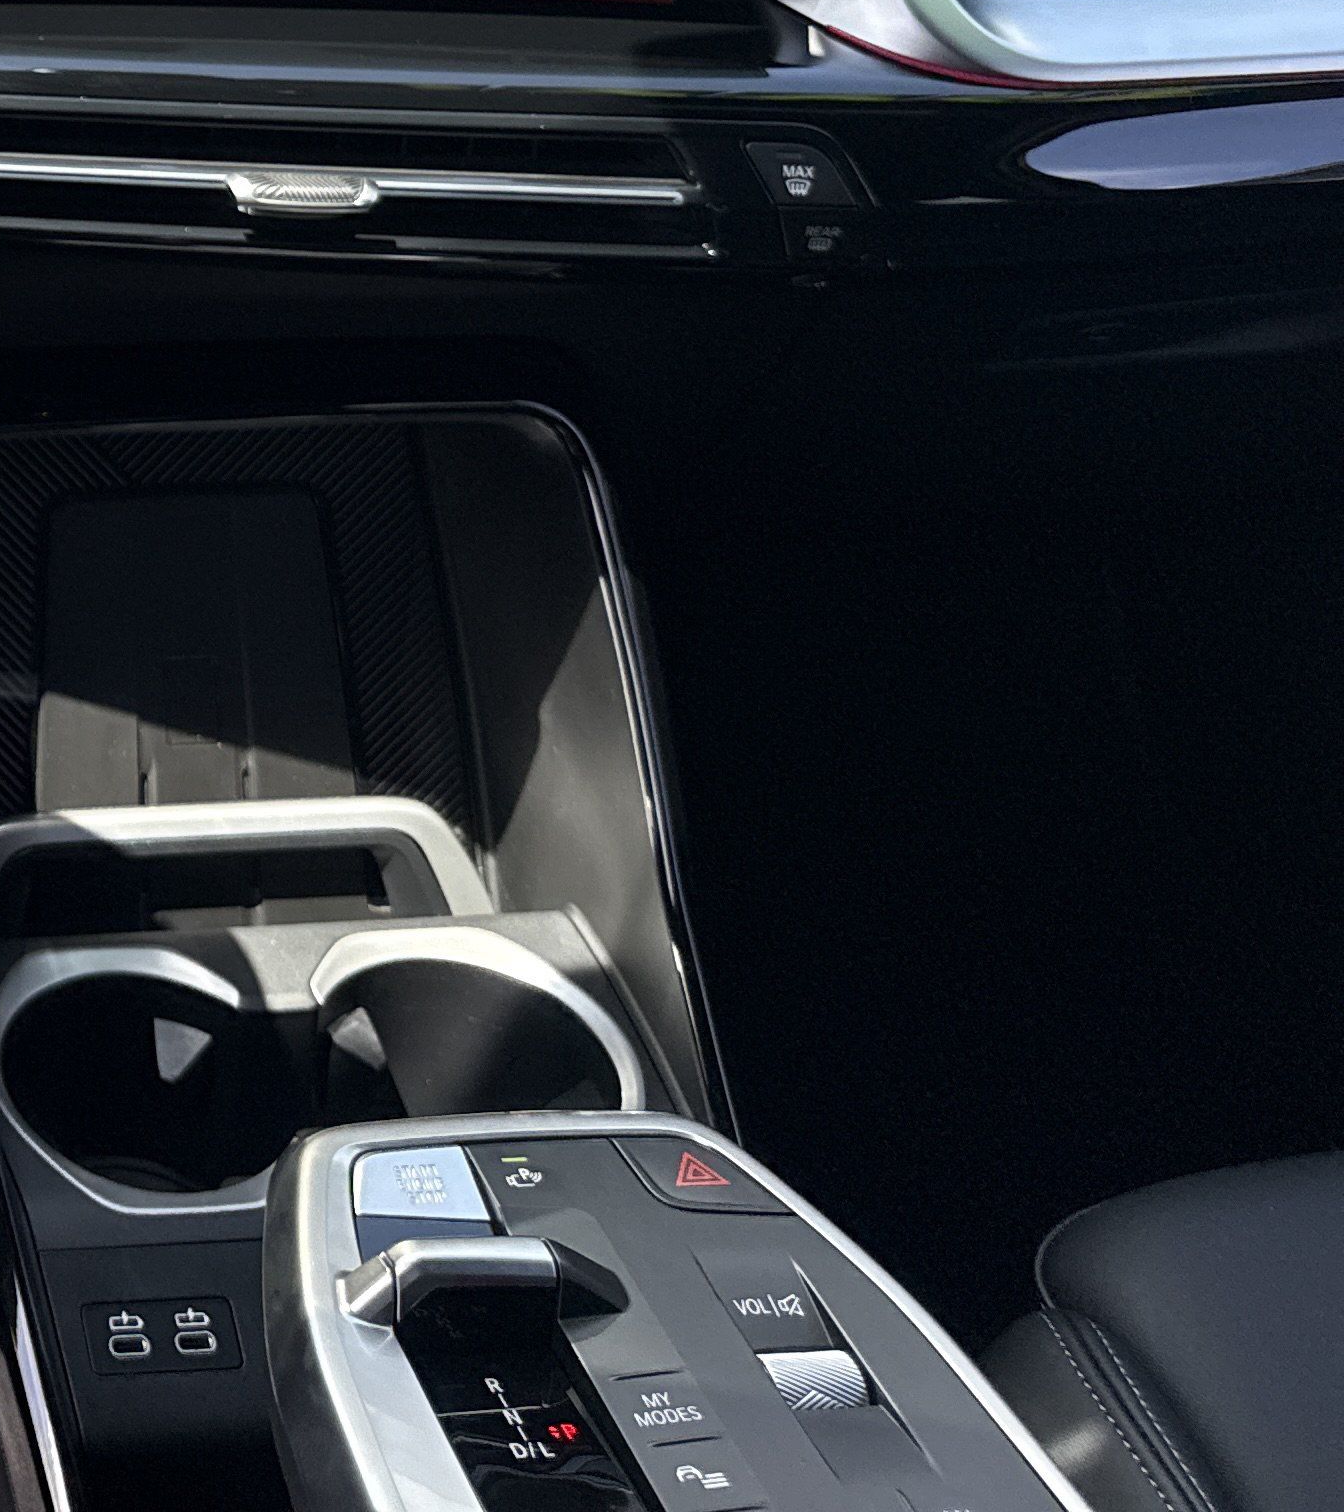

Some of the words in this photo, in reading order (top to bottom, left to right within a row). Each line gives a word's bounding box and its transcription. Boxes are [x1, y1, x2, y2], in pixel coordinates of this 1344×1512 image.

[782, 164, 815, 179] MAX
[733, 1298, 770, 1316] VOL
[485, 1378, 503, 1394] R
[641, 1392, 671, 1408] MY
[502, 1410, 523, 1426] N
[634, 1406, 703, 1428] MODES
[561, 1423, 581, 1441] P
